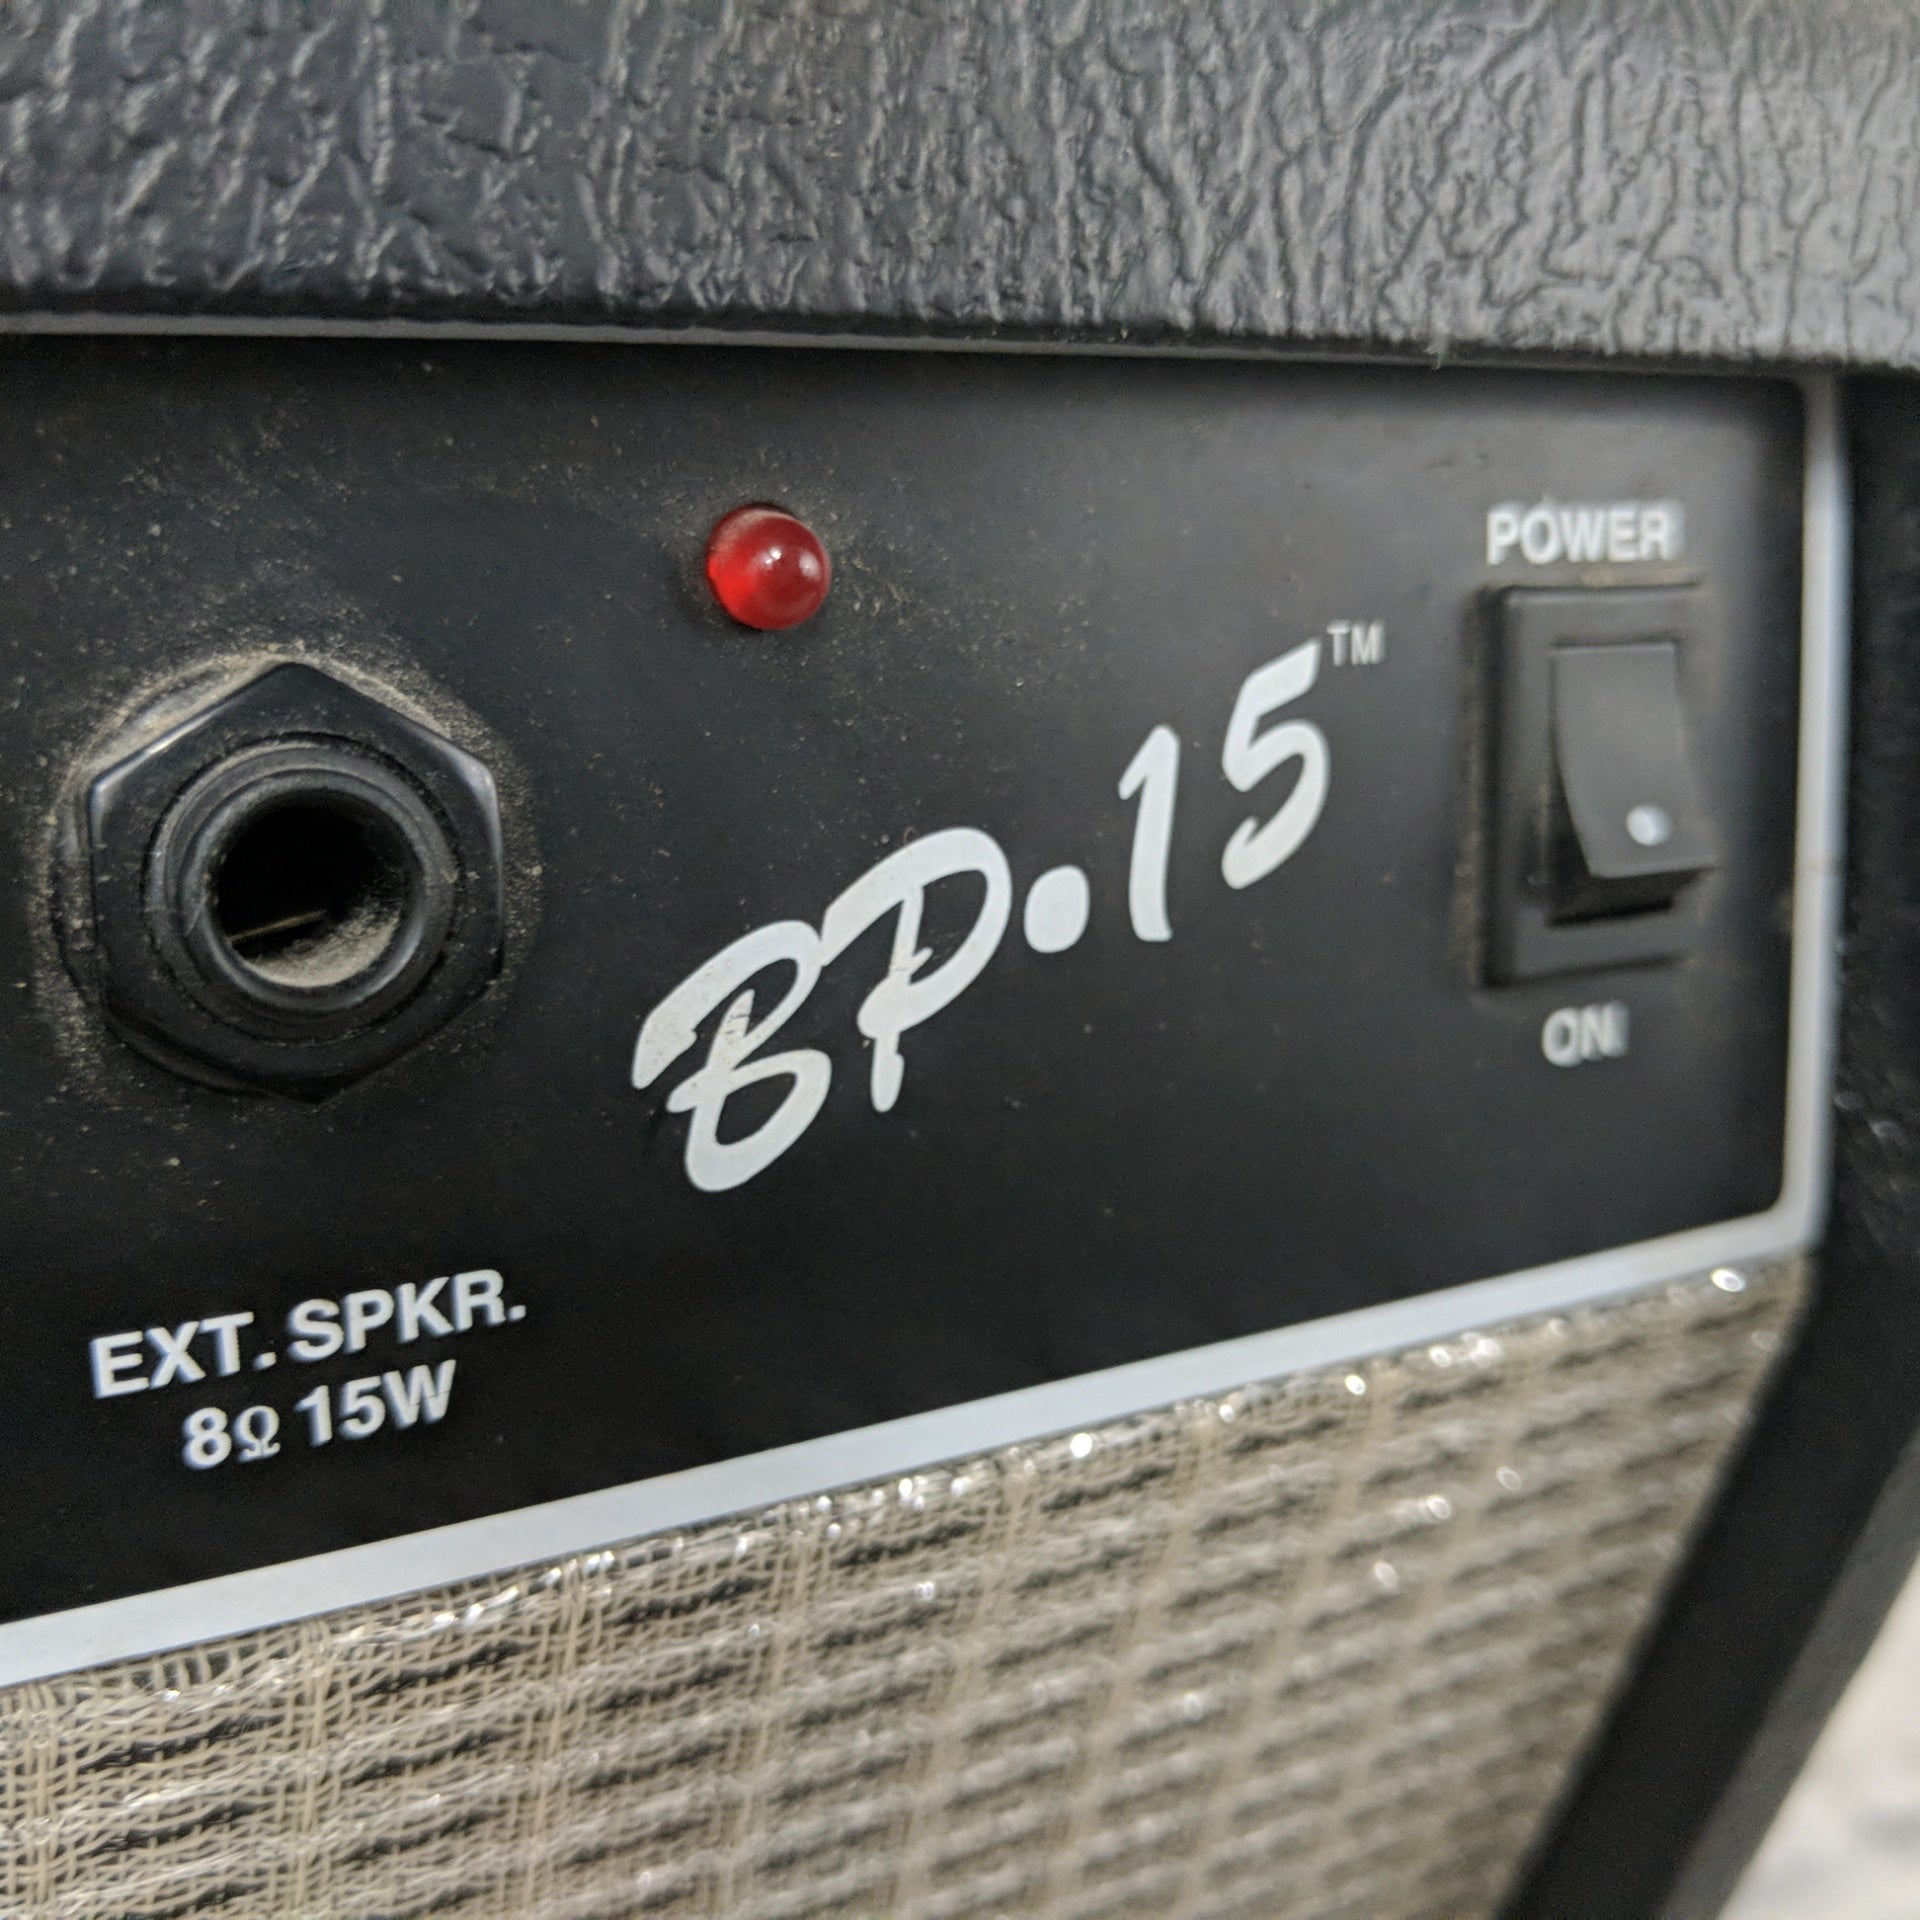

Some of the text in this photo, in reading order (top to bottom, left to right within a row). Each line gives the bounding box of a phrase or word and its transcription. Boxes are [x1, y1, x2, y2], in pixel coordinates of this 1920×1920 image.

[1484, 500, 1681, 565] POWER
[1542, 1003, 1627, 1067] ON
[91, 1268, 526, 1398] EXT. SPKR.
[294, 1358, 457, 1447] 15W
